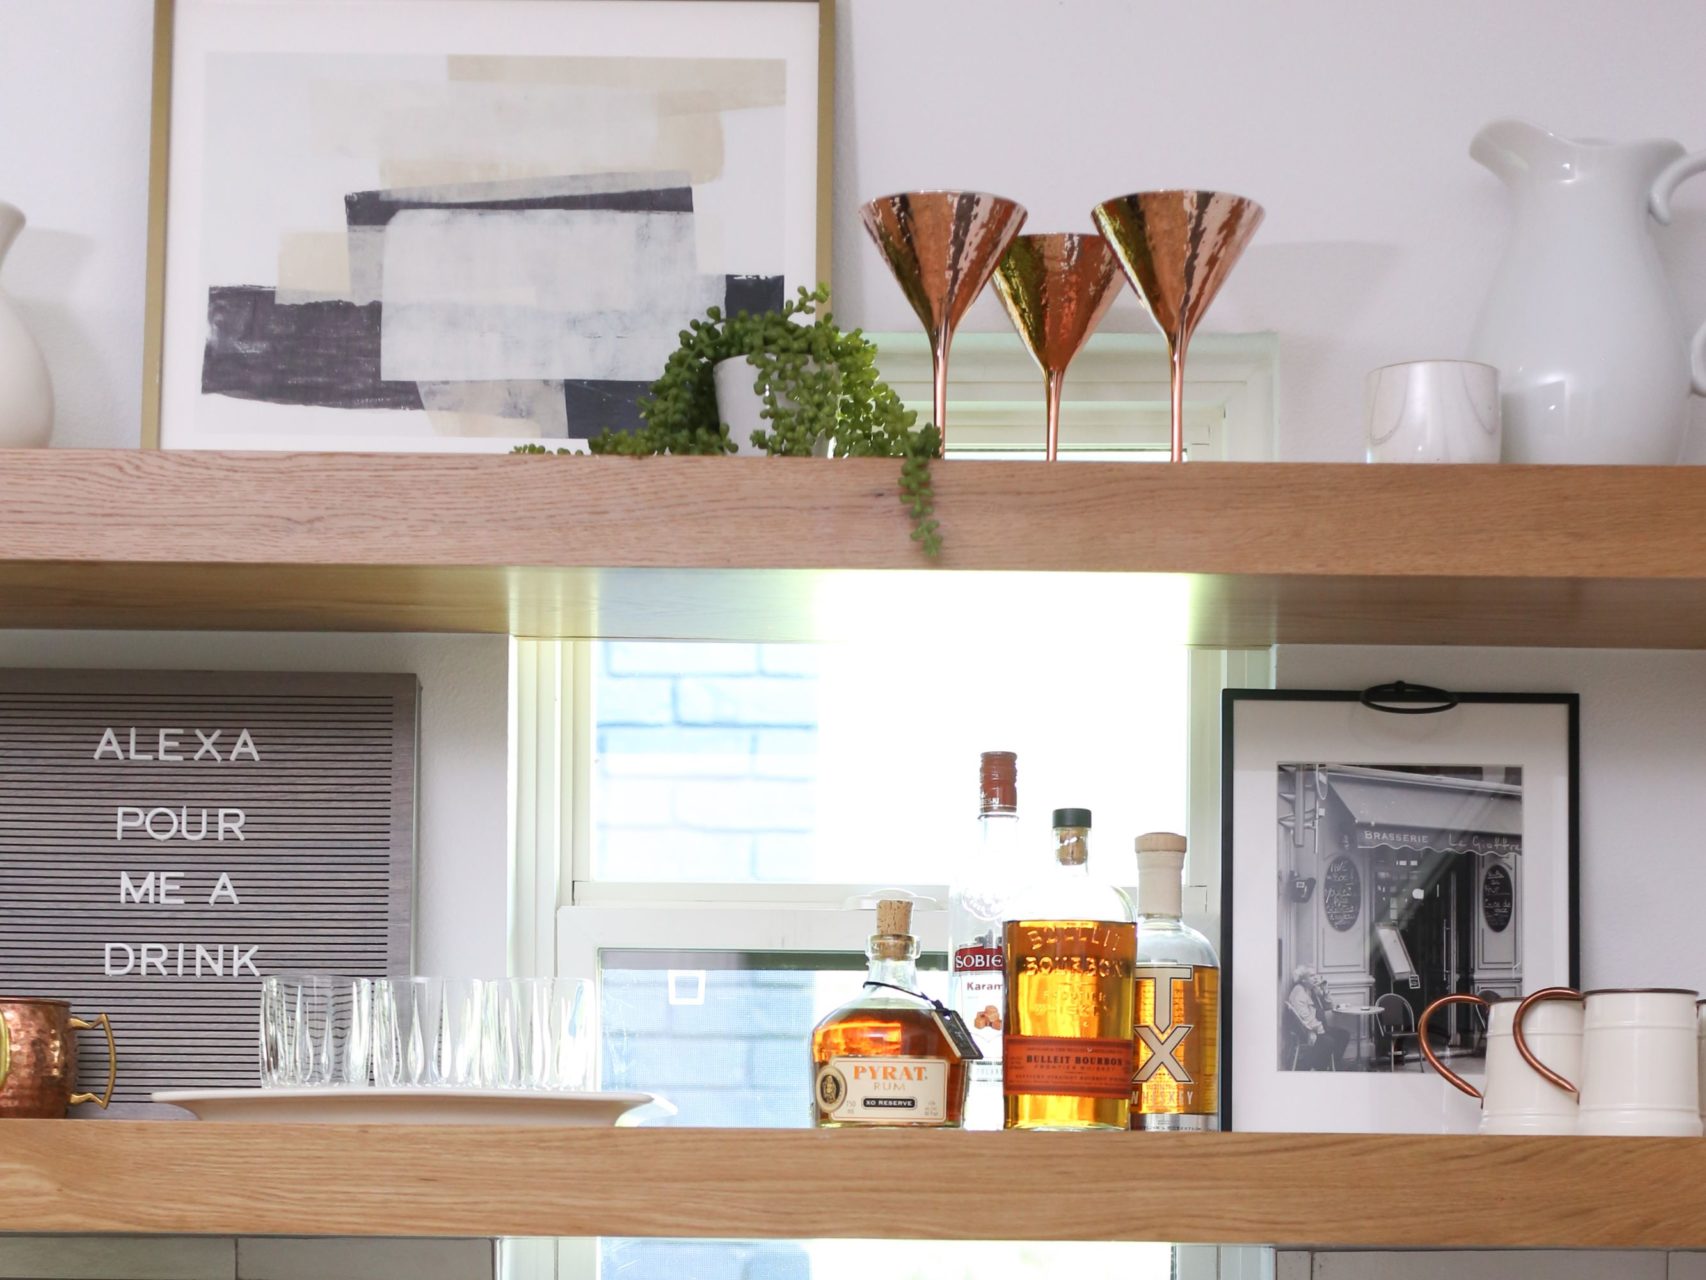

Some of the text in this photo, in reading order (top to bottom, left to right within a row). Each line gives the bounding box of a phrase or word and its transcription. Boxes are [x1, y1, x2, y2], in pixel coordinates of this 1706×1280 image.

[93, 727, 260, 763] ALEXA
[116, 805, 246, 842] POUR
[1364, 830, 1430, 844] BRASSERIE
[120, 871, 240, 906] ME A
[104, 942, 261, 978] DRINK
[955, 955, 1003, 969] SOBIE
[1026, 1055, 1070, 1065] BULLEIT
[1075, 1055, 1123, 1066] BOURBON
[853, 1065, 927, 1081] PYRAT
[873, 1082, 906, 1091] RUM
